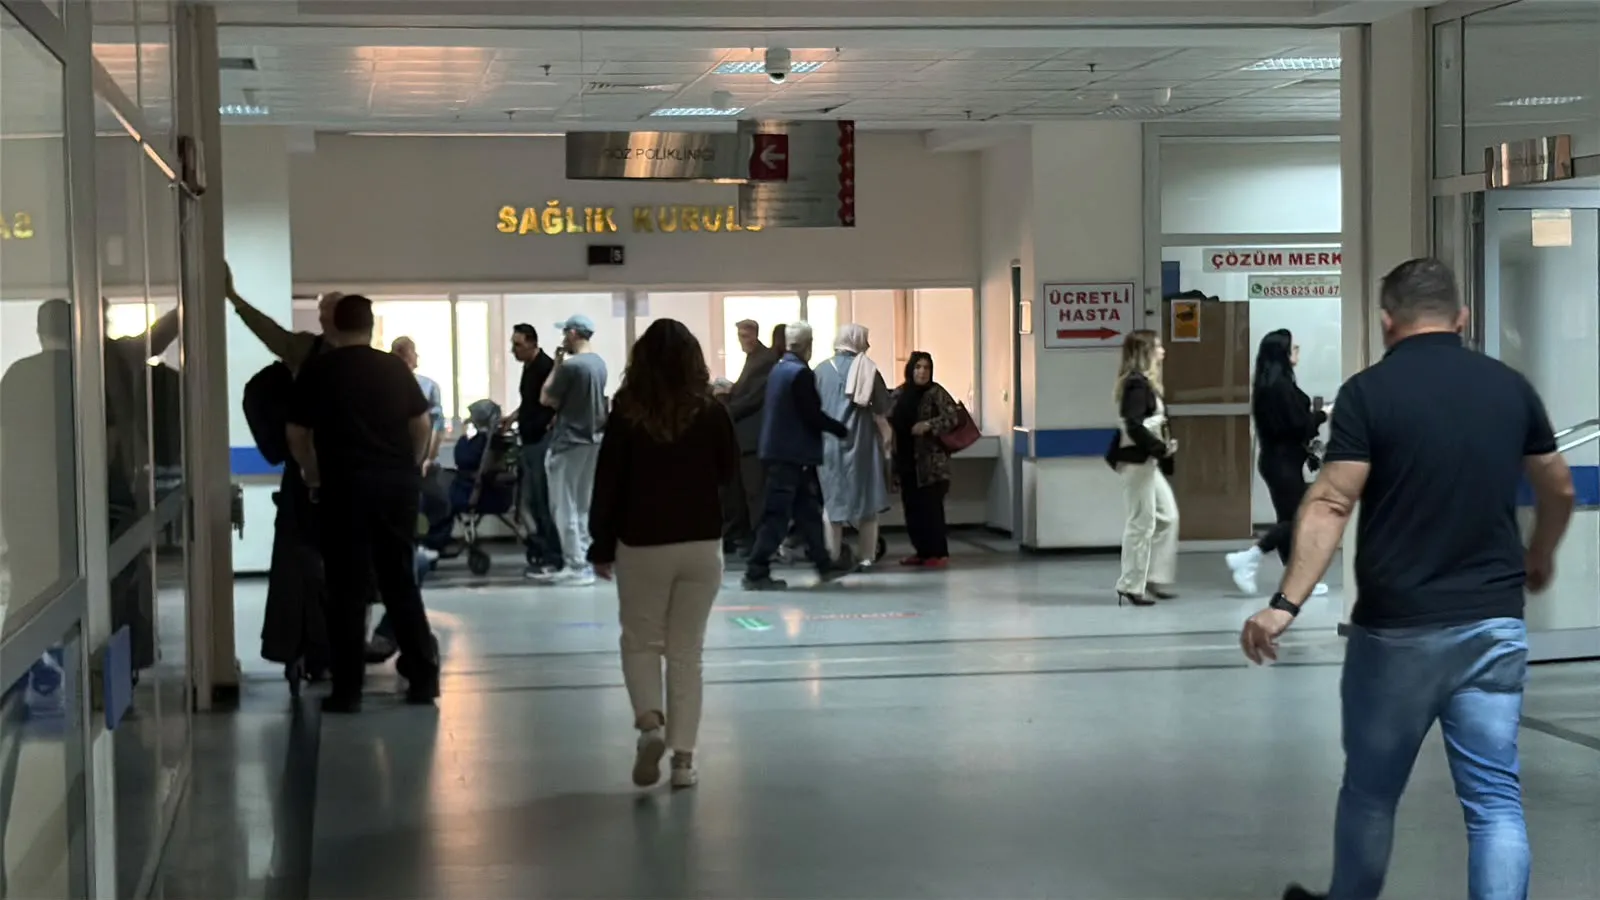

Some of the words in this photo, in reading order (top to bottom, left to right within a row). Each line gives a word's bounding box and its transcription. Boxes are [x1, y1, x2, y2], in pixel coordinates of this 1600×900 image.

[631, 204, 765, 234] KURUL
[1211, 249, 1283, 270] ÇÖZÜM
[1288, 251, 1342, 267] MERK
[1049, 288, 1130, 305] ÜCRETLİ
[1058, 308, 1121, 321] HASTA
